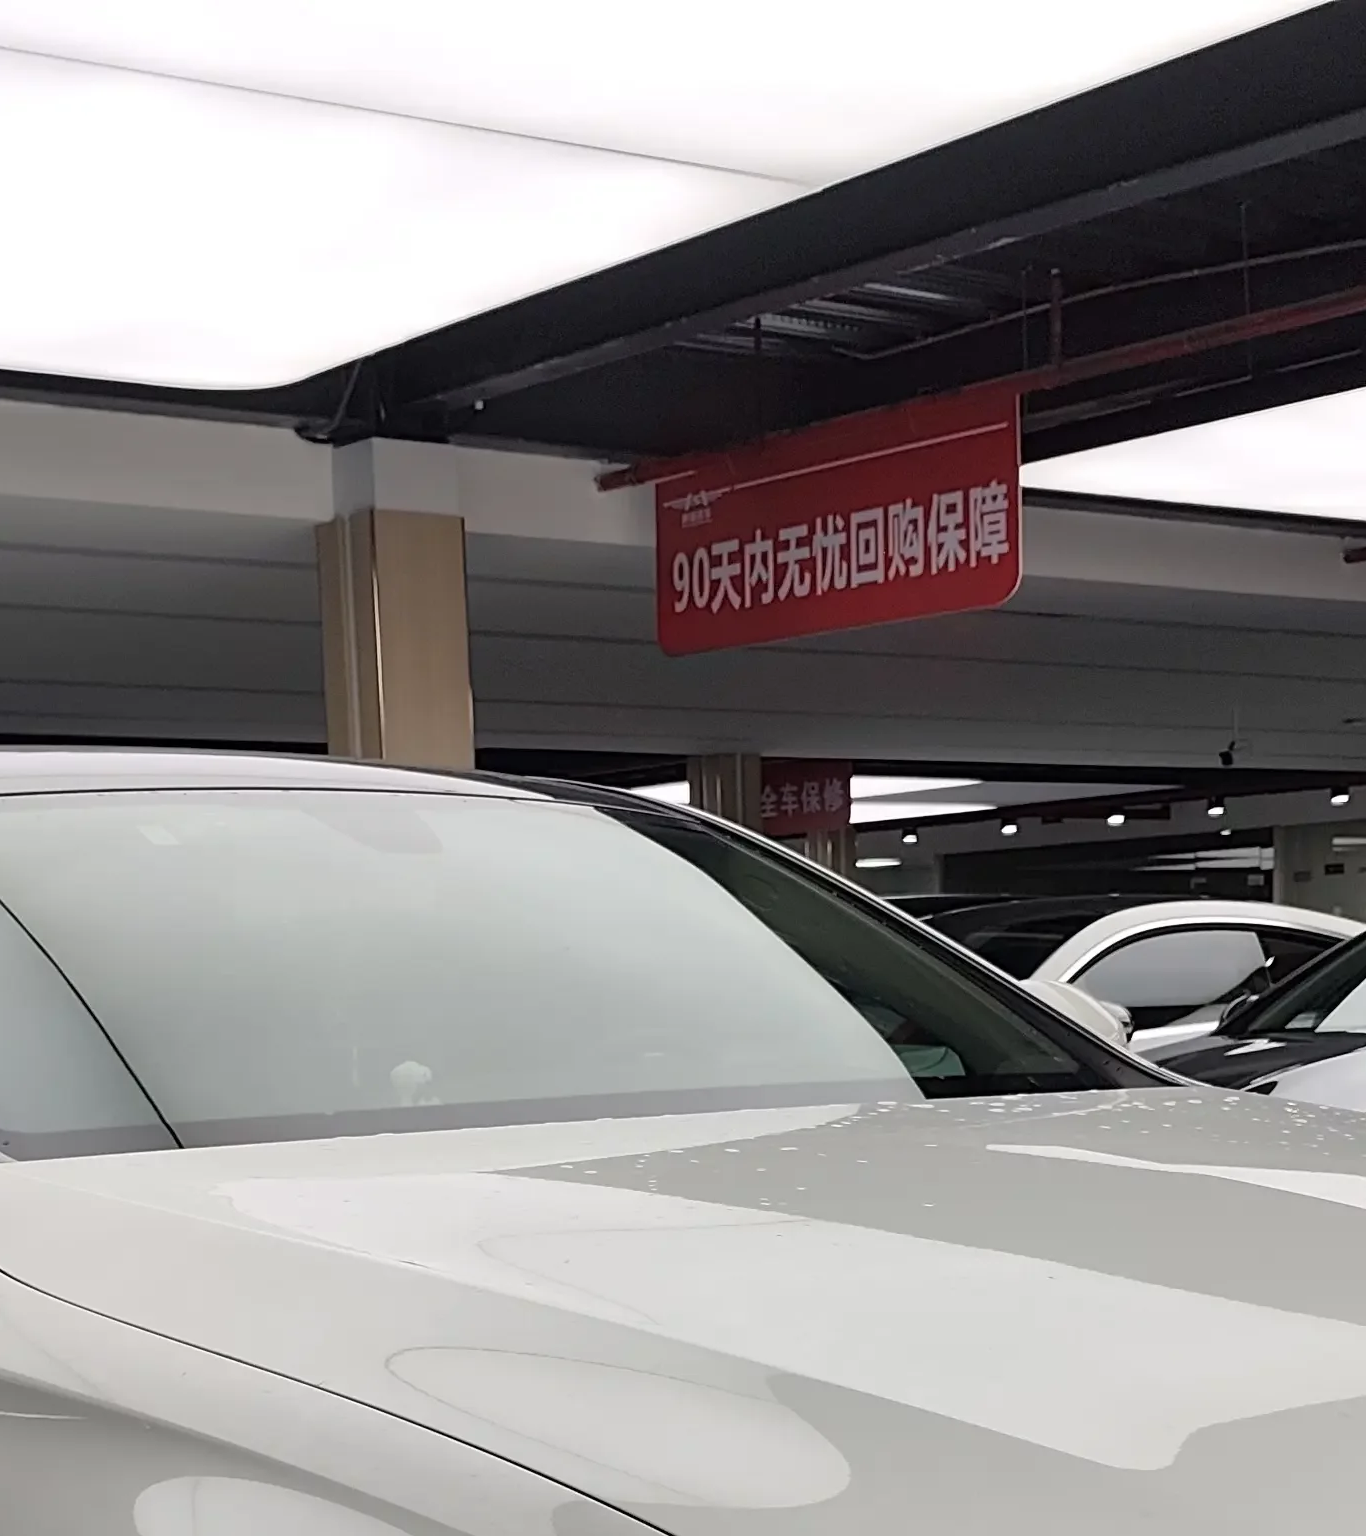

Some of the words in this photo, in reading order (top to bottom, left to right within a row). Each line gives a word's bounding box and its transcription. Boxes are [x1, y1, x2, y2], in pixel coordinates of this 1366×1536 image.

[671, 479, 1010, 614] 90天内无忧回购保障
